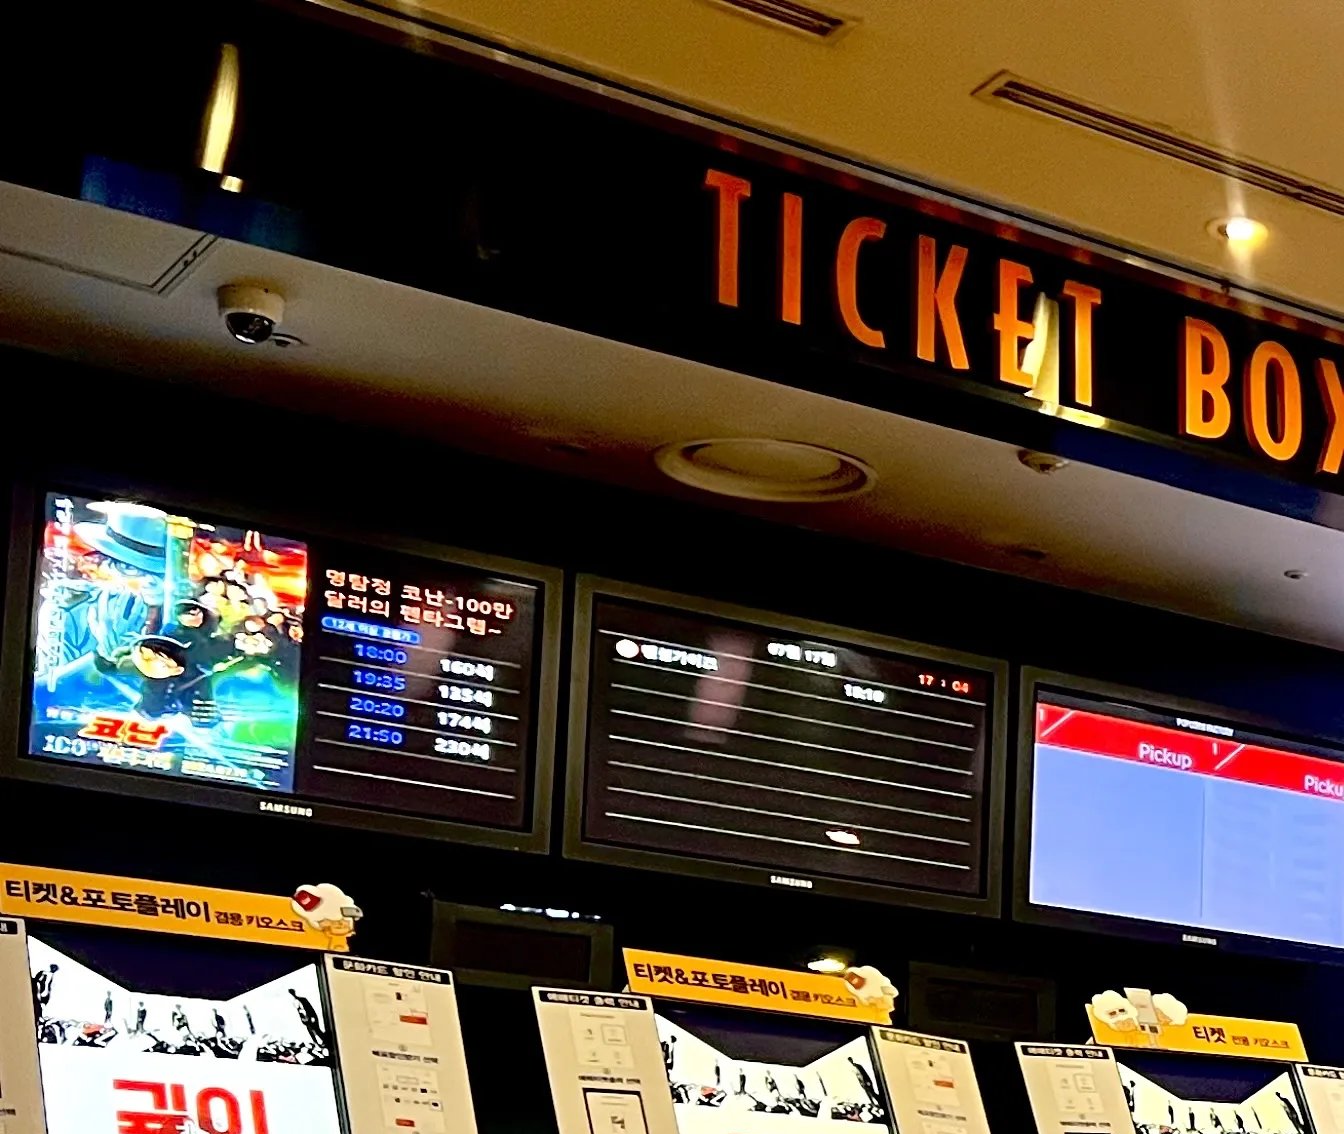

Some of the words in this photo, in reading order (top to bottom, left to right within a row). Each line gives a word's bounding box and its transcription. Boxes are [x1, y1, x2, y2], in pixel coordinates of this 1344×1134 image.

[705, 169, 1101, 406] TICKET
[326, 569, 391, 595] 명탐정
[324, 590, 390, 618] 달러의
[354, 644, 408, 664] 18:00
[353, 670, 406, 691] 19:35
[350, 697, 404, 717] 20:20
[84, 715, 169, 748] 코난
[348, 725, 403, 744] 21:50
[1138, 742, 1194, 772] Pickup
[259, 801, 313, 817] SAMSUNG
[769, 874, 813, 890] SAMSUNG
[4, 878, 211, 924] 티켓&포토플레이
[246, 914, 306, 934] 키오스크
[633, 962, 788, 1000] 티켓&포토플레이
[1192, 1024, 1228, 1045] 티켓
